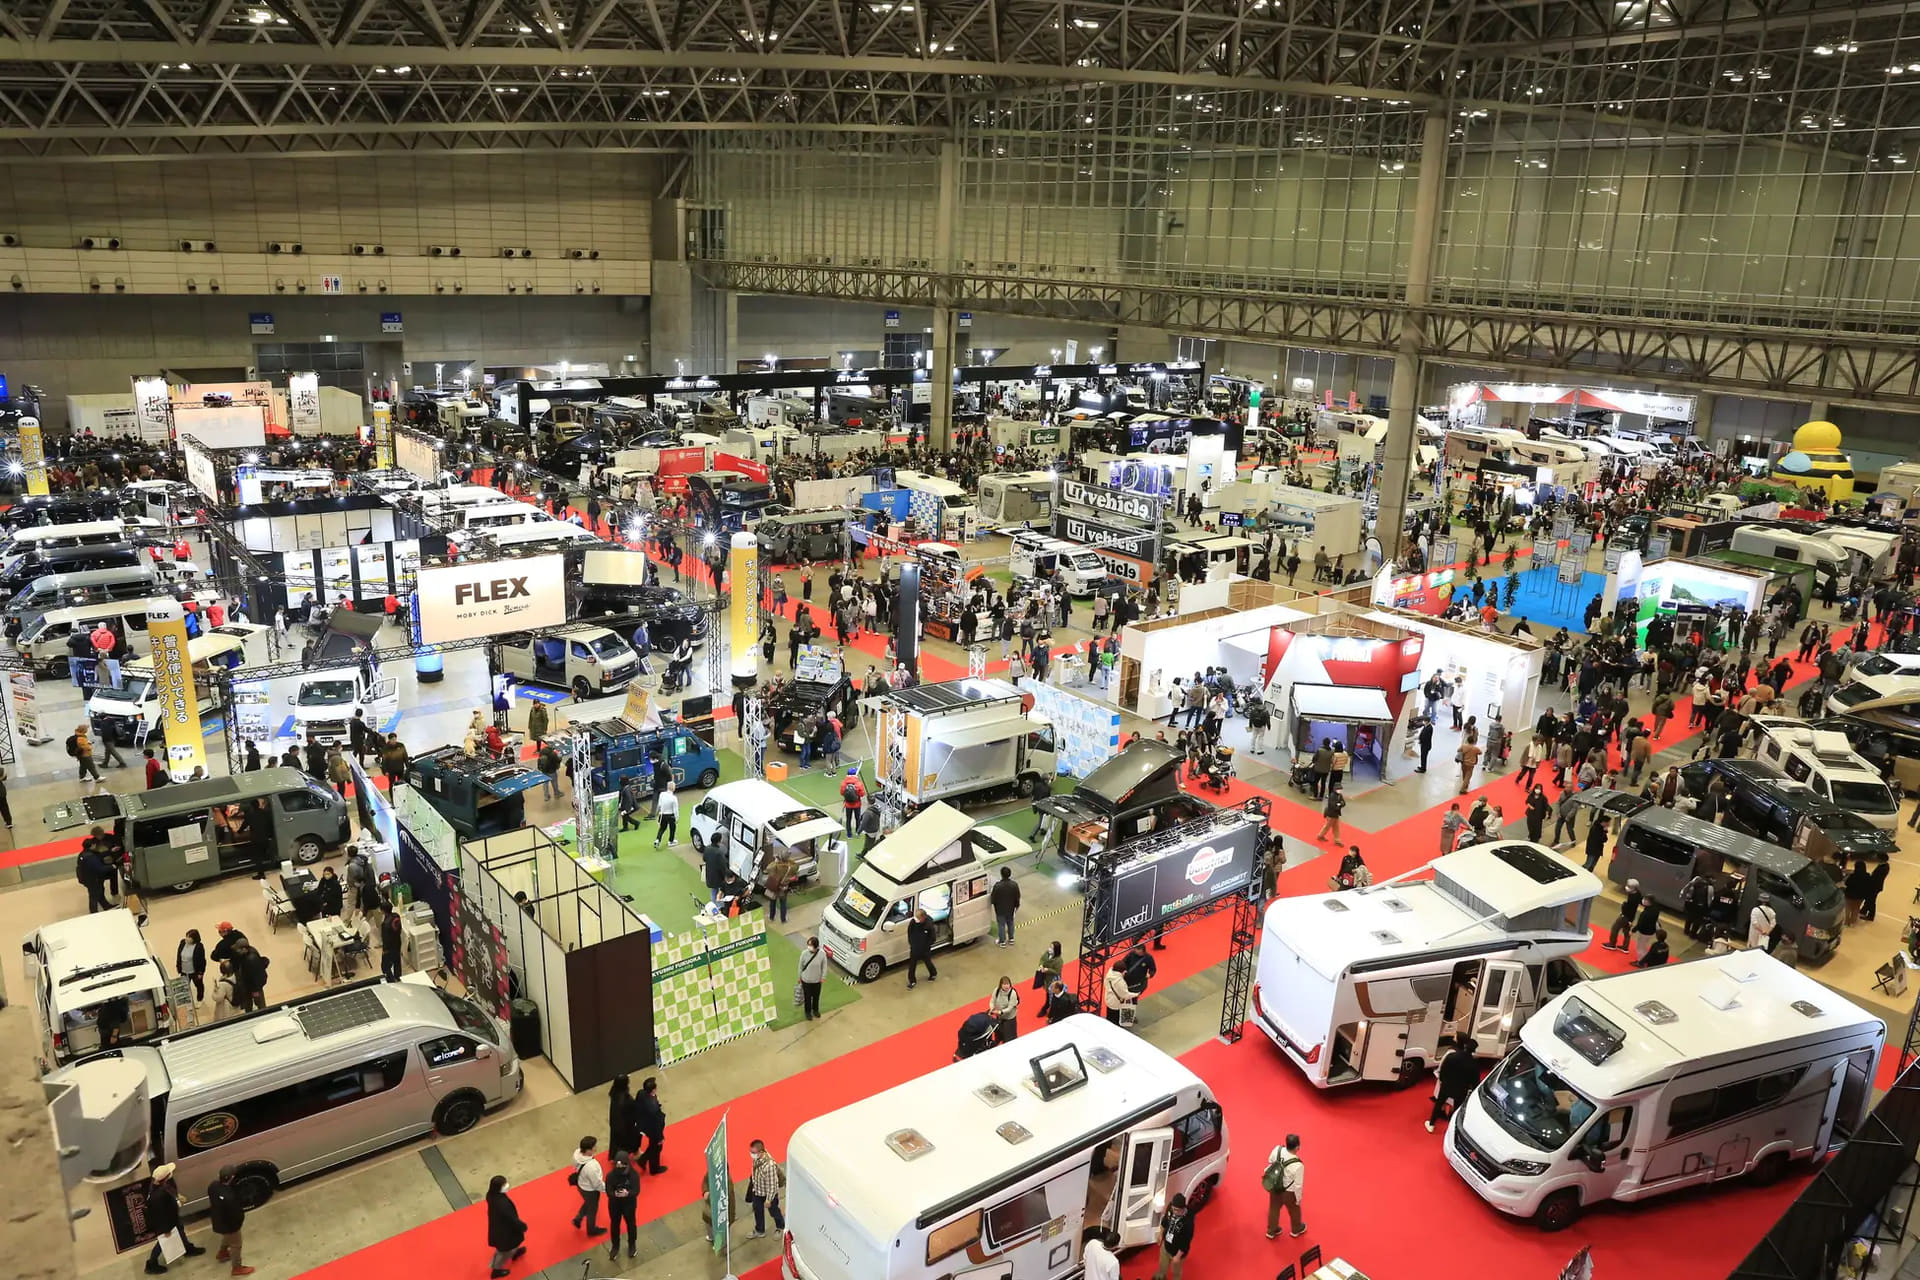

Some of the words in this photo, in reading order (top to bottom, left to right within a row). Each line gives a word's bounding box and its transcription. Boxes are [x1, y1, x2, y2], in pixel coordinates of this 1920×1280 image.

[1087, 491, 1149, 520] vehicle
[455, 576, 530, 606] FLEX
[147, 611, 170, 620] FLEX
[457, 611, 477, 619] MOBY
[480, 608, 498, 617] DICK
[151, 636, 171, 731] キャンピングカー
[163, 634, 189, 725] 普段使いできる
[736, 935, 761, 947] FUKUOKA
[675, 955, 702, 971] FUKUOKA
